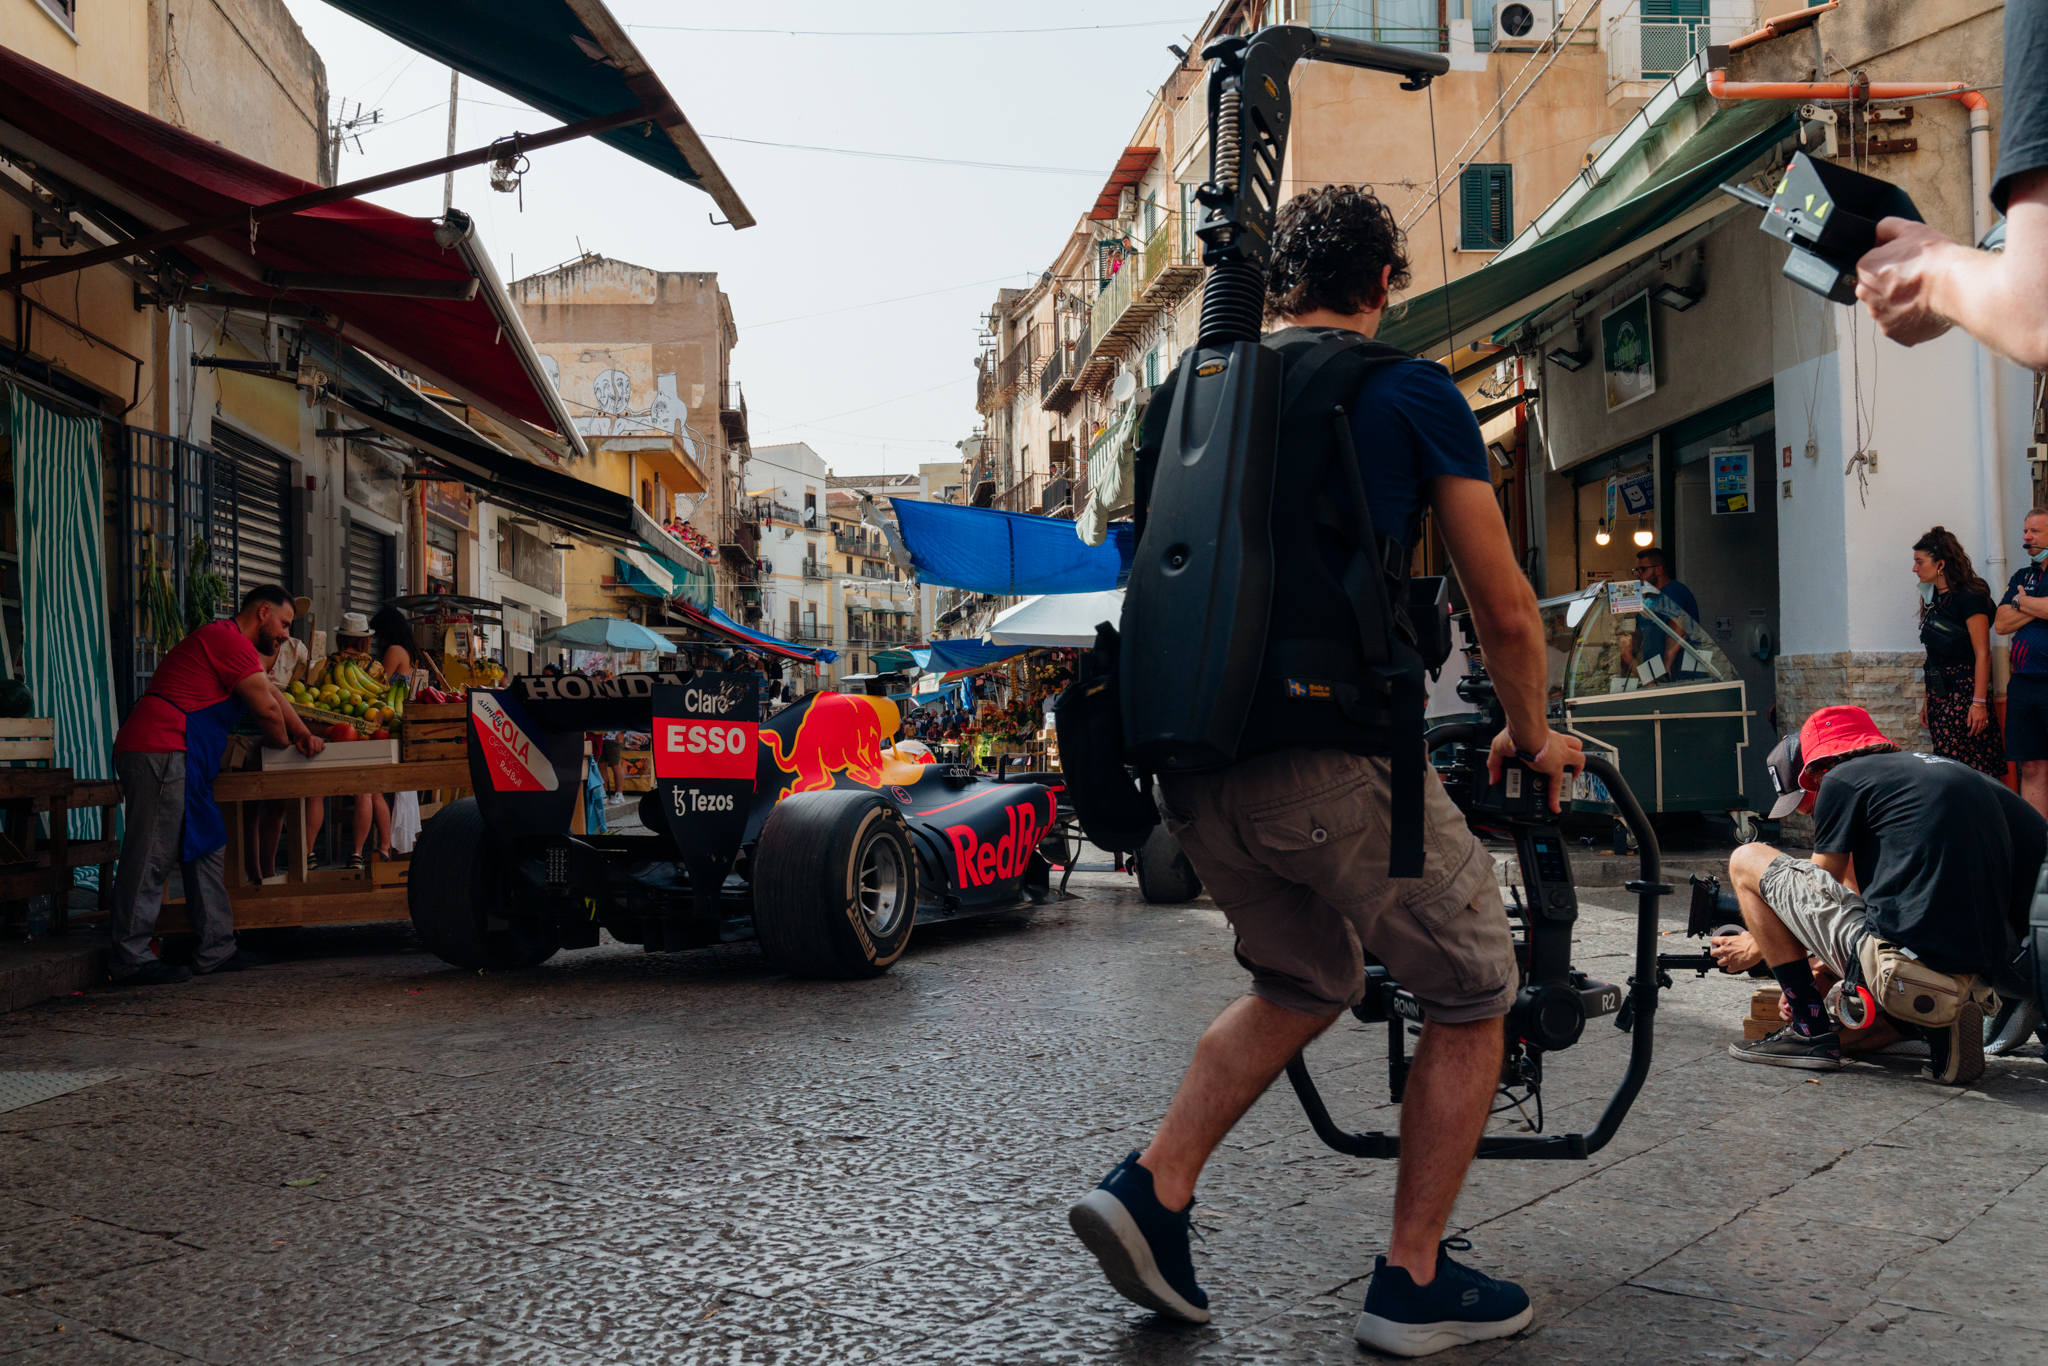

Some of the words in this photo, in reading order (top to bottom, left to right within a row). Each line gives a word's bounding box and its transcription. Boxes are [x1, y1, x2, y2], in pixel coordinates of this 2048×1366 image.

[477, 699, 502, 727] simply
[685, 688, 729, 714] Claro
[492, 709, 530, 766] COLA
[667, 725, 746, 754] ESSO
[488, 735, 521, 773] ORGANICS
[689, 788, 734, 812] Tezos
[1393, 996, 1420, 1019] RONIN
[1601, 992, 1616, 1012] R2
